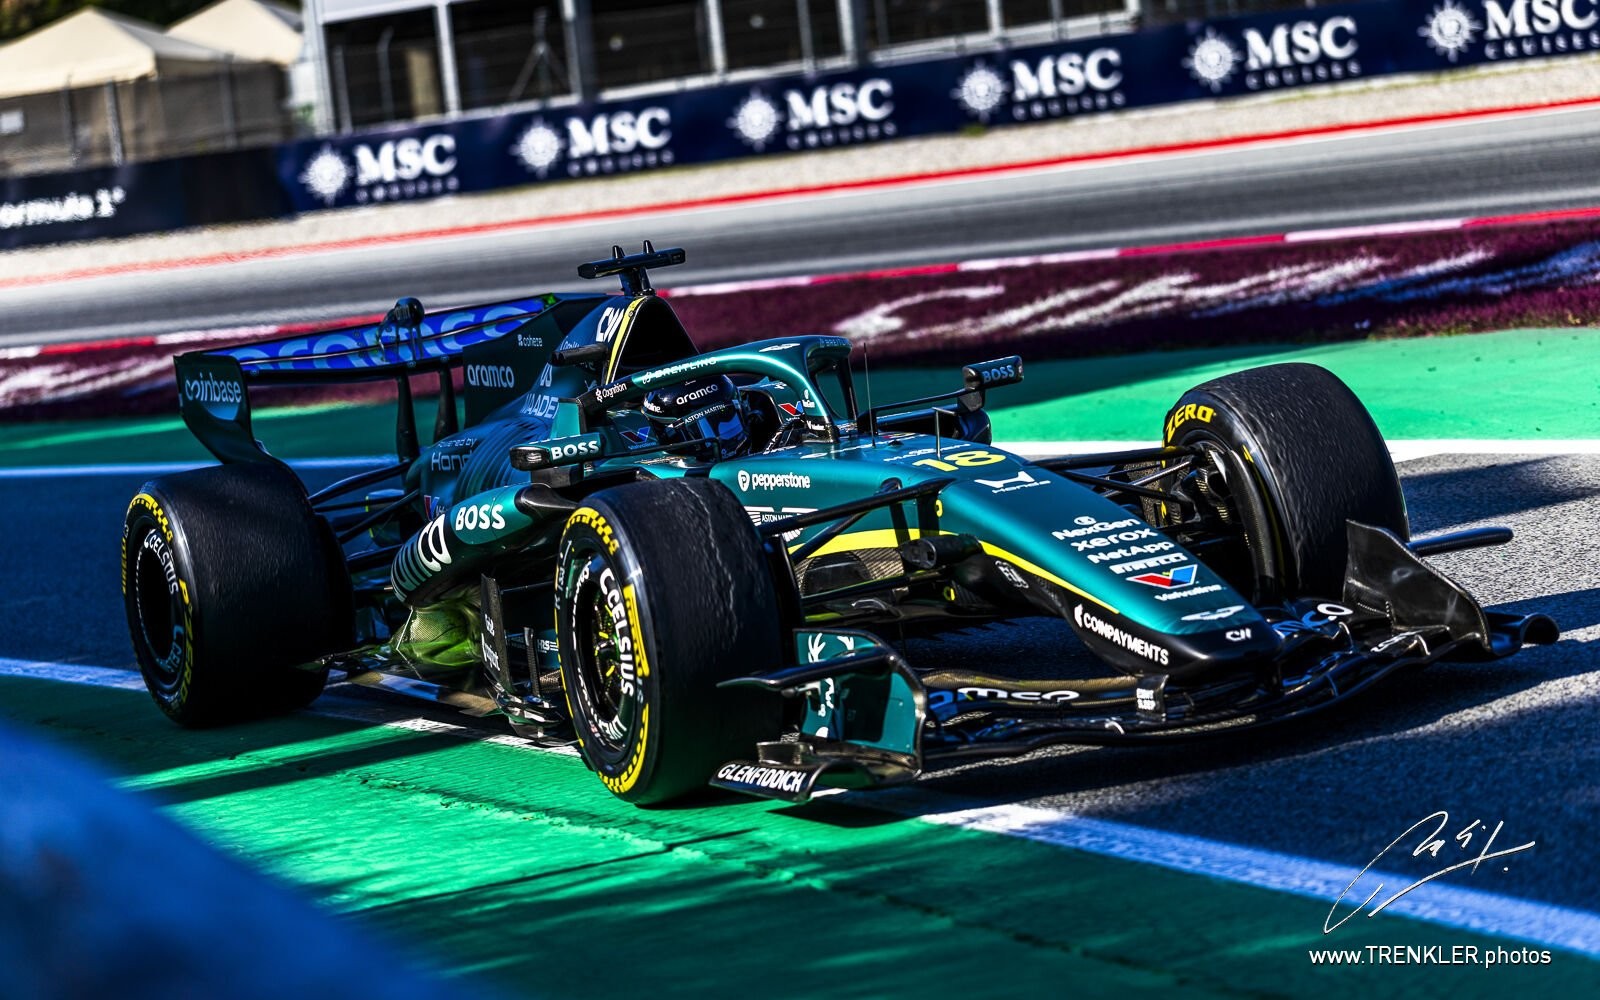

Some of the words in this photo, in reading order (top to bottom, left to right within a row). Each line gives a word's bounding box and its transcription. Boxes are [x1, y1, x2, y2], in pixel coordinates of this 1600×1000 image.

[1483, 0, 1600, 39] MSC
[1244, 17, 1358, 70] MSC
[1011, 48, 1122, 99] MSC
[787, 79, 894, 130] MSC
[567, 107, 672, 158] MSC
[354, 133, 457, 183] MSC
[0, 192, 95, 228] ormula
[185, 371, 242, 403] coinbase
[467, 364, 514, 388] aramco
[982, 365, 1015, 383] BOSS
[602, 382, 627, 399] Cognition
[676, 384, 719, 405] aramco
[685, 411, 704, 424] ASTON
[704, 404, 726, 415] MARTIN
[1165, 403, 1214, 443] ZERO
[551, 440, 599, 461] BOSS
[912, 451, 1006, 472] 18
[752, 472, 811, 490] pepperstone
[455, 504, 506, 531] BOSS
[1052, 518, 1141, 541] NexGen
[1070, 527, 1158, 551] xerox
[1087, 540, 1175, 564] NetApp
[149, 534, 179, 595] CELSIUS
[1109, 552, 1188, 574] PIRELLI
[1154, 584, 1223, 602] Valvoline
[607, 588, 635, 697] CELSIUS
[1083, 612, 1169, 665] COINPAYMENTS
[717, 763, 807, 793] GLENFIDDICH
